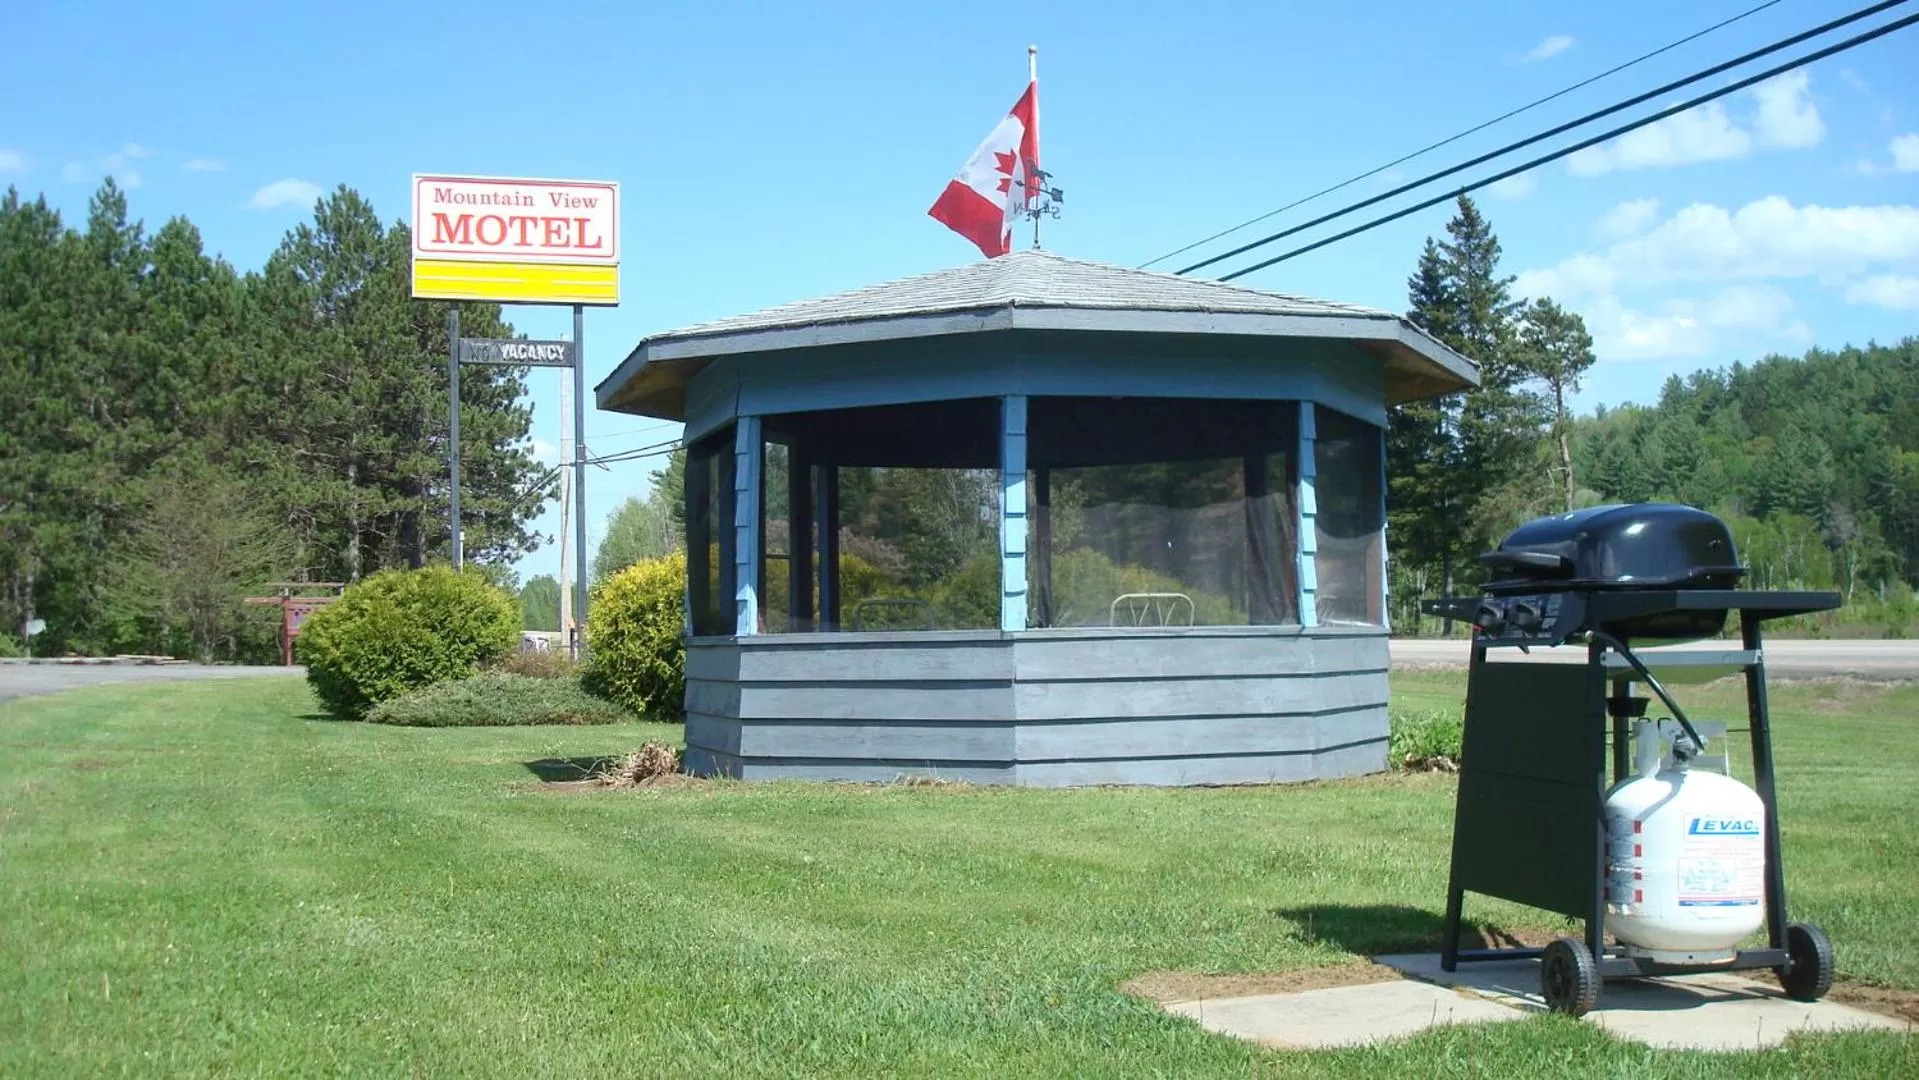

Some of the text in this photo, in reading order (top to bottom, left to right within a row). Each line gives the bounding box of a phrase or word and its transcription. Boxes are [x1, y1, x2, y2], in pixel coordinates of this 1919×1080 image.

[434, 187, 599, 208] Mountain View
[431, 212, 602, 249] MOTEL
[501, 343, 565, 361] VACANCY
